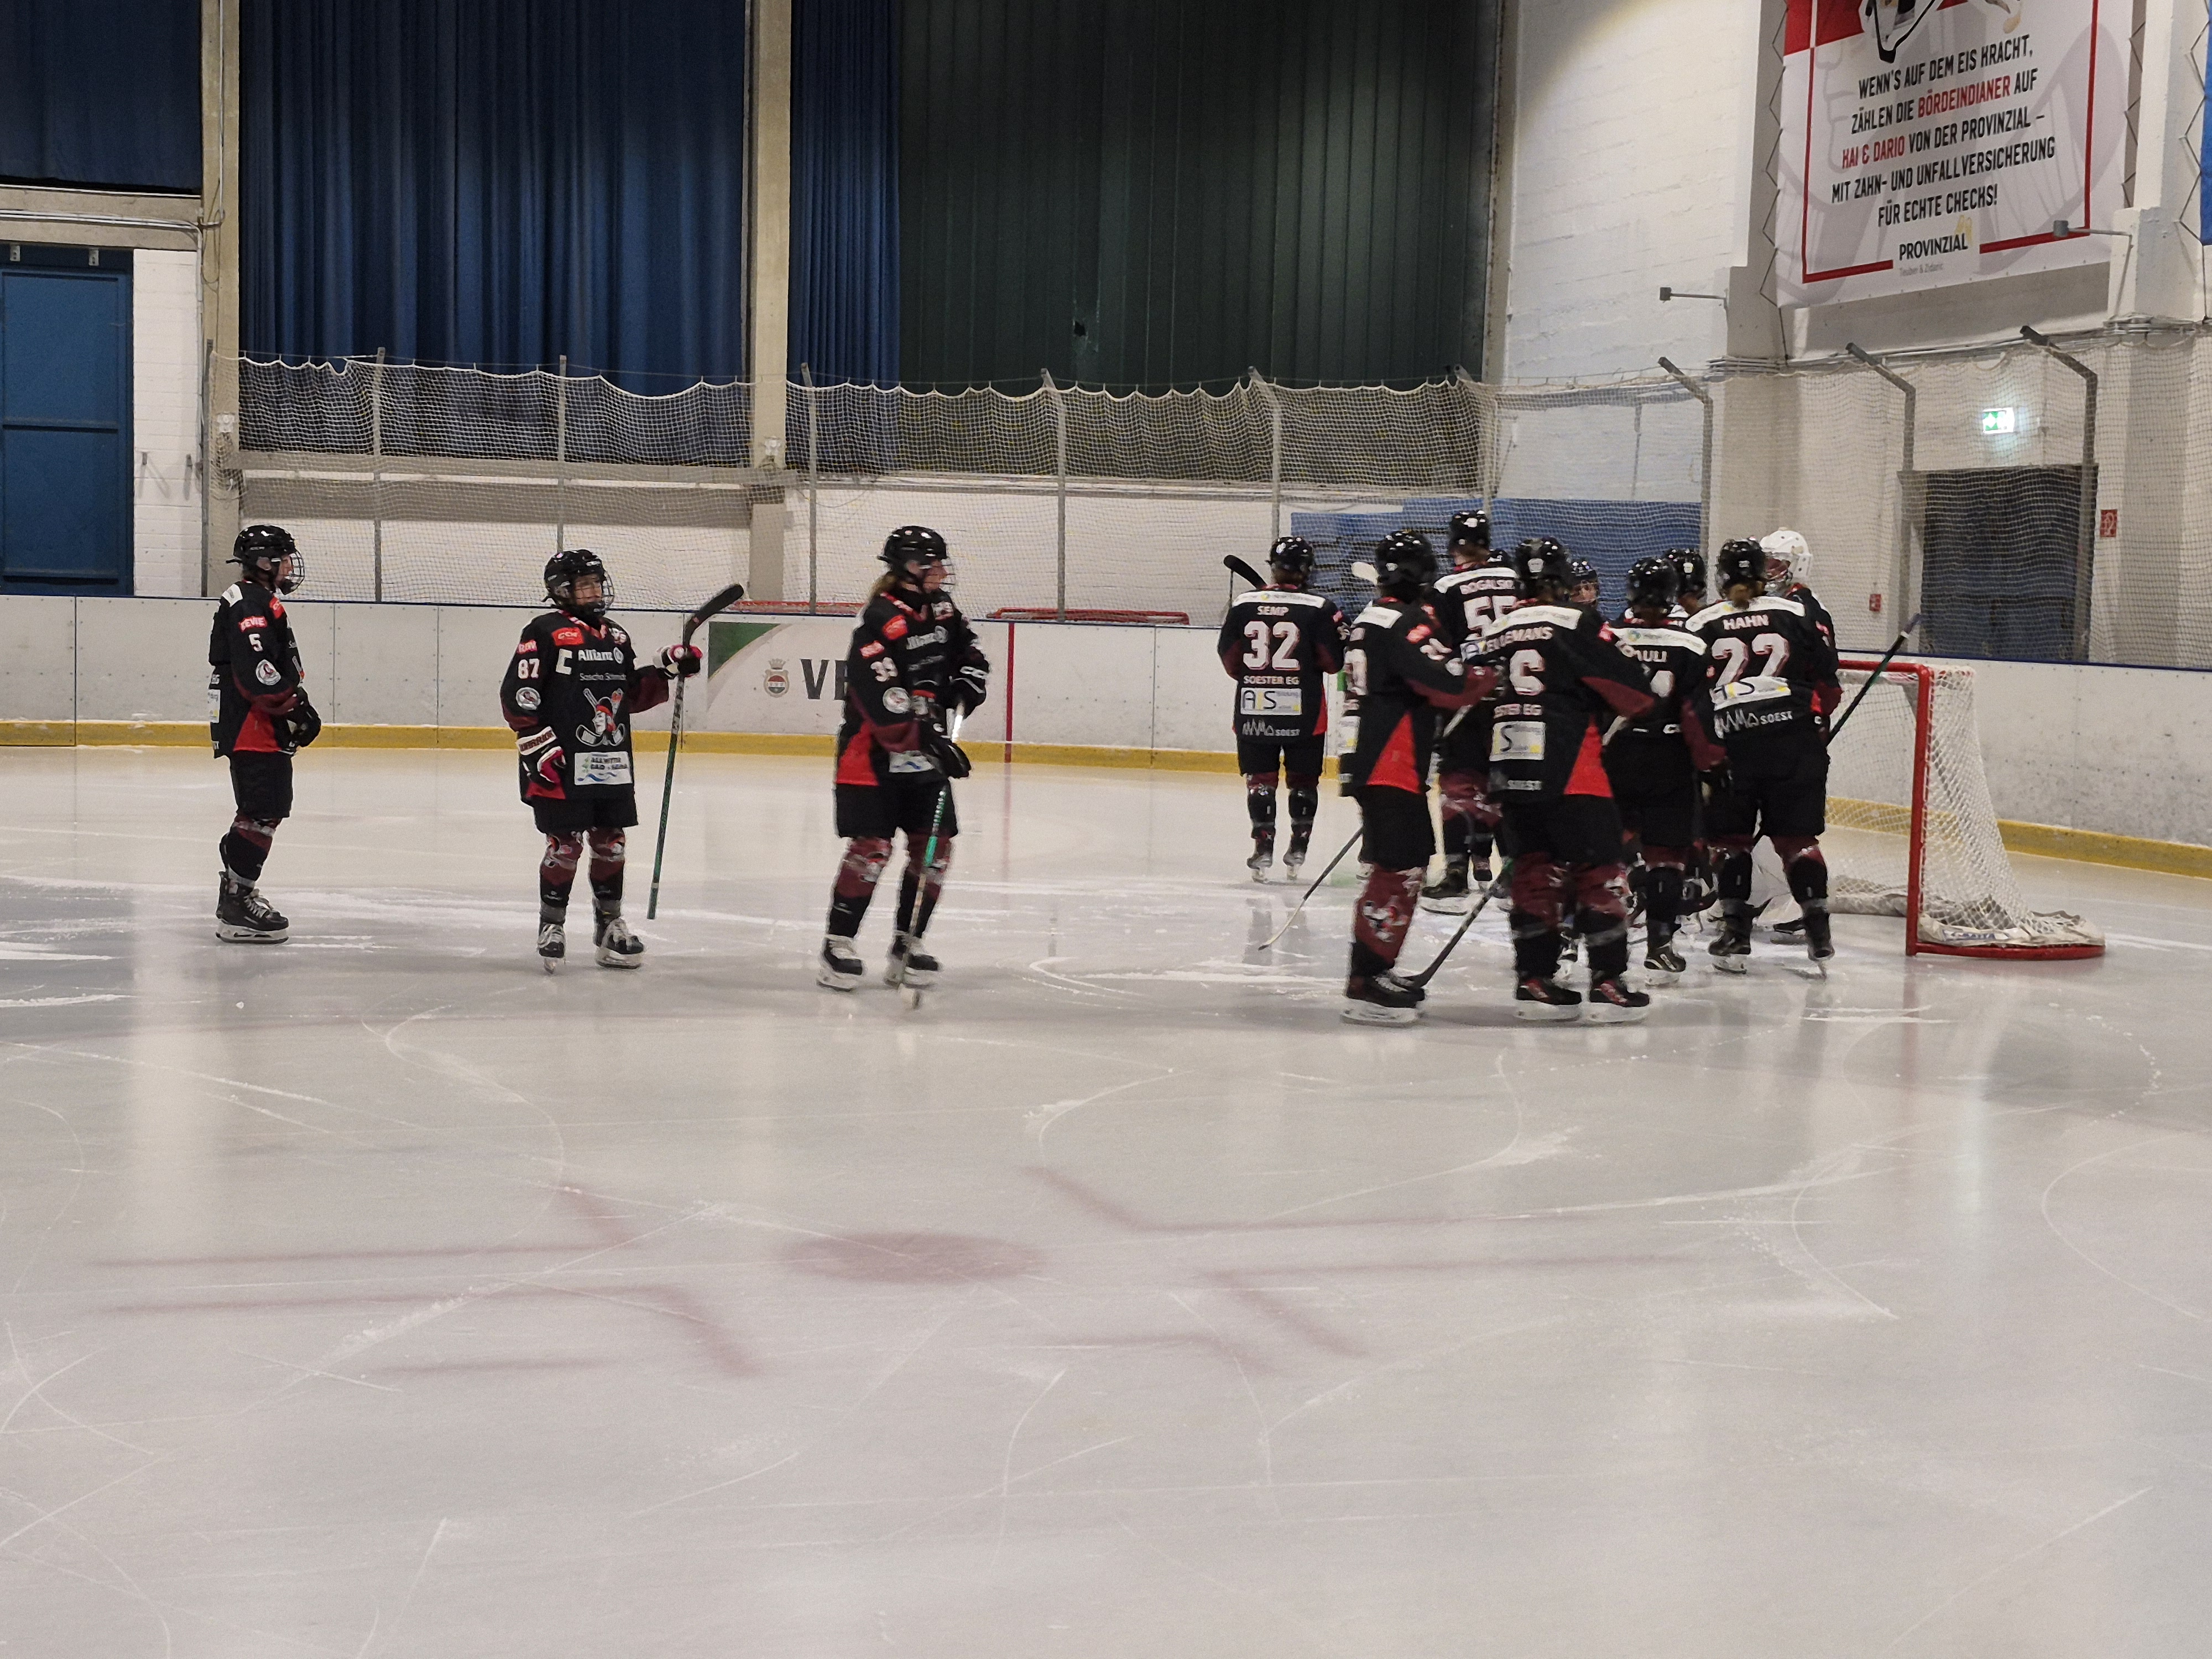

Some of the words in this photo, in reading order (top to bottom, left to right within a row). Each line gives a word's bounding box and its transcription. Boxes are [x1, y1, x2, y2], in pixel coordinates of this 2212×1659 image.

[1859, 69, 1901, 100] WENN'S
[1904, 62, 1926, 87] AUF
[1929, 54, 1954, 81] DEM
[1958, 49, 1977, 74] EIS
[1981, 34, 2033, 67] KRACHT,
[1851, 105, 1893, 134] ZÄHLEN
[1896, 100, 1915, 124] DIE
[1918, 75, 2011, 118] BÖRDEINDIANER
[2014, 67, 2038, 95] AUF
[1842, 146, 1859, 169] KAI
[1862, 144, 1870, 164] &
[1874, 135, 1905, 162] DARIO
[1908, 133, 1931, 154] VON
[1935, 123, 1957, 148] DER
[1961, 106, 2031, 138] PROVINZIAL
[1832, 181, 1851, 204] MIT
[1854, 174, 1887, 199] ZAHN-
[1891, 167, 1913, 192] UND
[1917, 136, 2056, 186] UNFALLVERSICHERUNG
[1878, 200, 1901, 227] FÜR
[1904, 195, 1942, 222] ECHTE
[1946, 183, 1998, 214] CHECKS!
[1899, 233, 1968, 261] PROVINZIAL
[249, 633, 263, 652] 5
[1723, 614, 1770, 630] HAHN
[578, 649, 614, 661] Allianz
[1243, 620, 1300, 670] 32
[1712, 633, 1790, 687] 22
[518, 658, 540, 679] 87
[1244, 676, 1284, 685] SOESTER
[1286, 676, 1300, 685] EG
[1510, 649, 1546, 696] 6
[1760, 711, 1793, 725] SOEST
